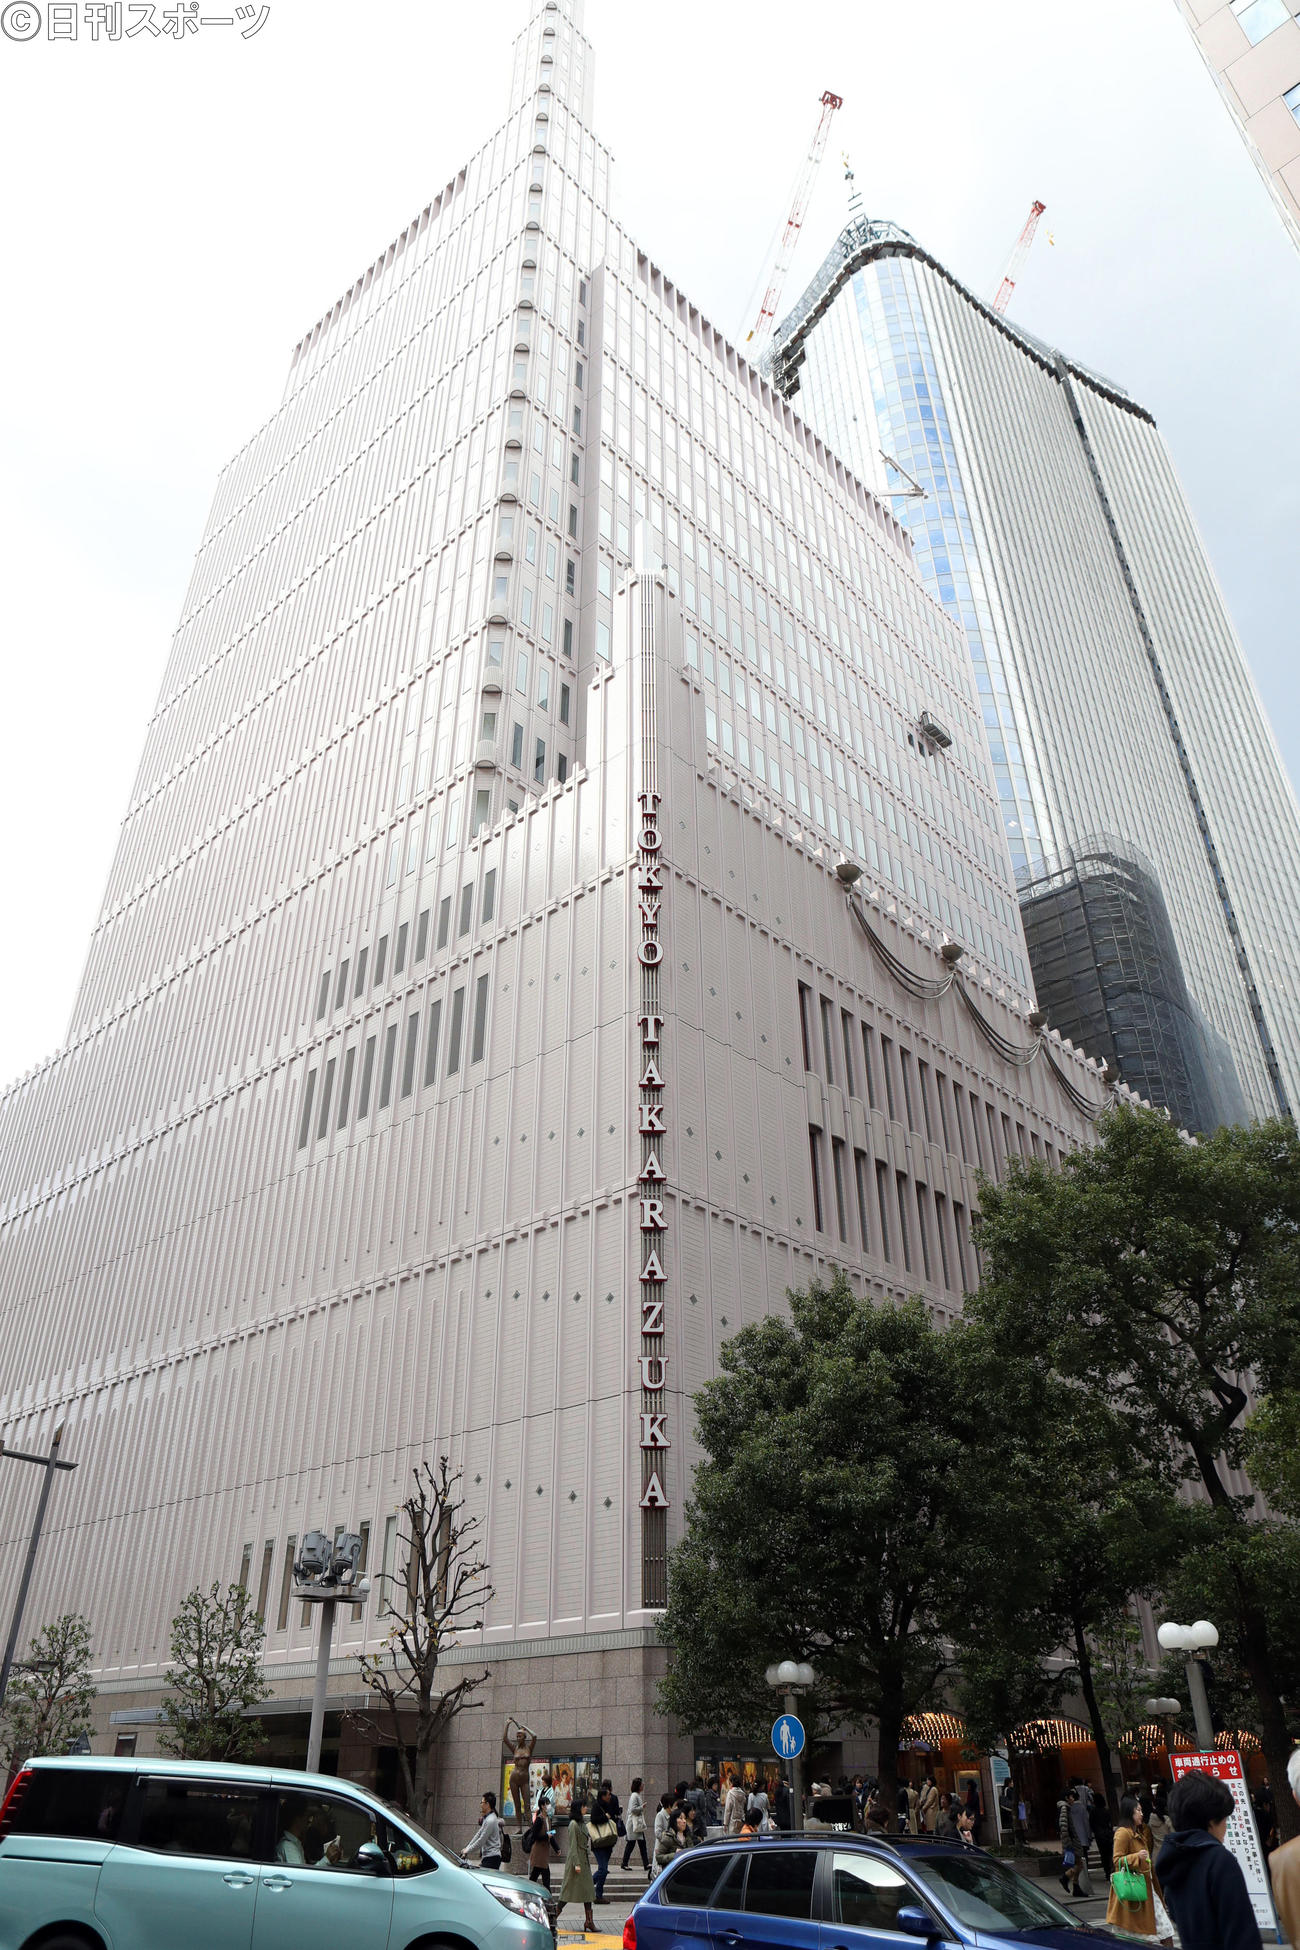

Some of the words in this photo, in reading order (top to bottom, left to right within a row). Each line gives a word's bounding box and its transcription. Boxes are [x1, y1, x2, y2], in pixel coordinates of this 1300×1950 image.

[637, 791, 664, 967] TOKYO
[637, 1014, 671, 1509] TAKARAZUKA
[1174, 1754, 1236, 1768] 車両通行止めの
[1176, 1765, 1238, 1779] おらせ
